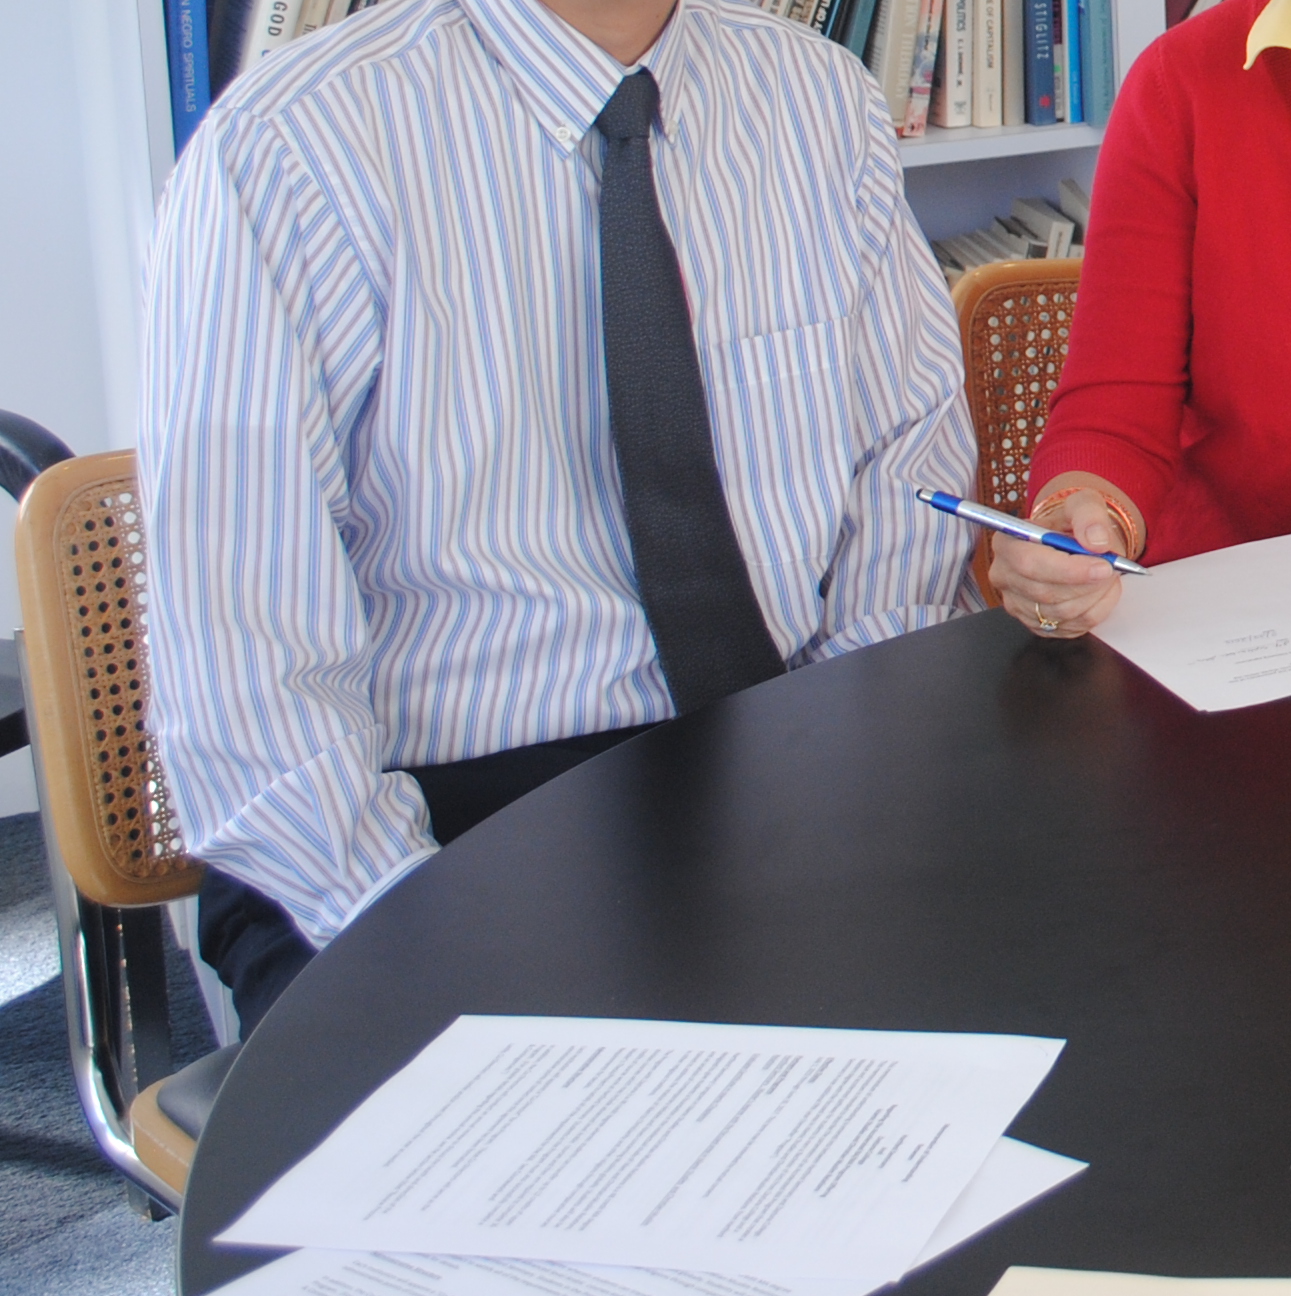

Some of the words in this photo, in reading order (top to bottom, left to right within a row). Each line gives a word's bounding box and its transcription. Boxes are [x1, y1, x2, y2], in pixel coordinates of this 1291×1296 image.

[180, 9, 193, 48] NEGRO
[264, 0, 291, 38] GOD
[1034, 2, 1049, 59] STIGLITZ
[181, 52, 196, 111] SPIRITUALS
